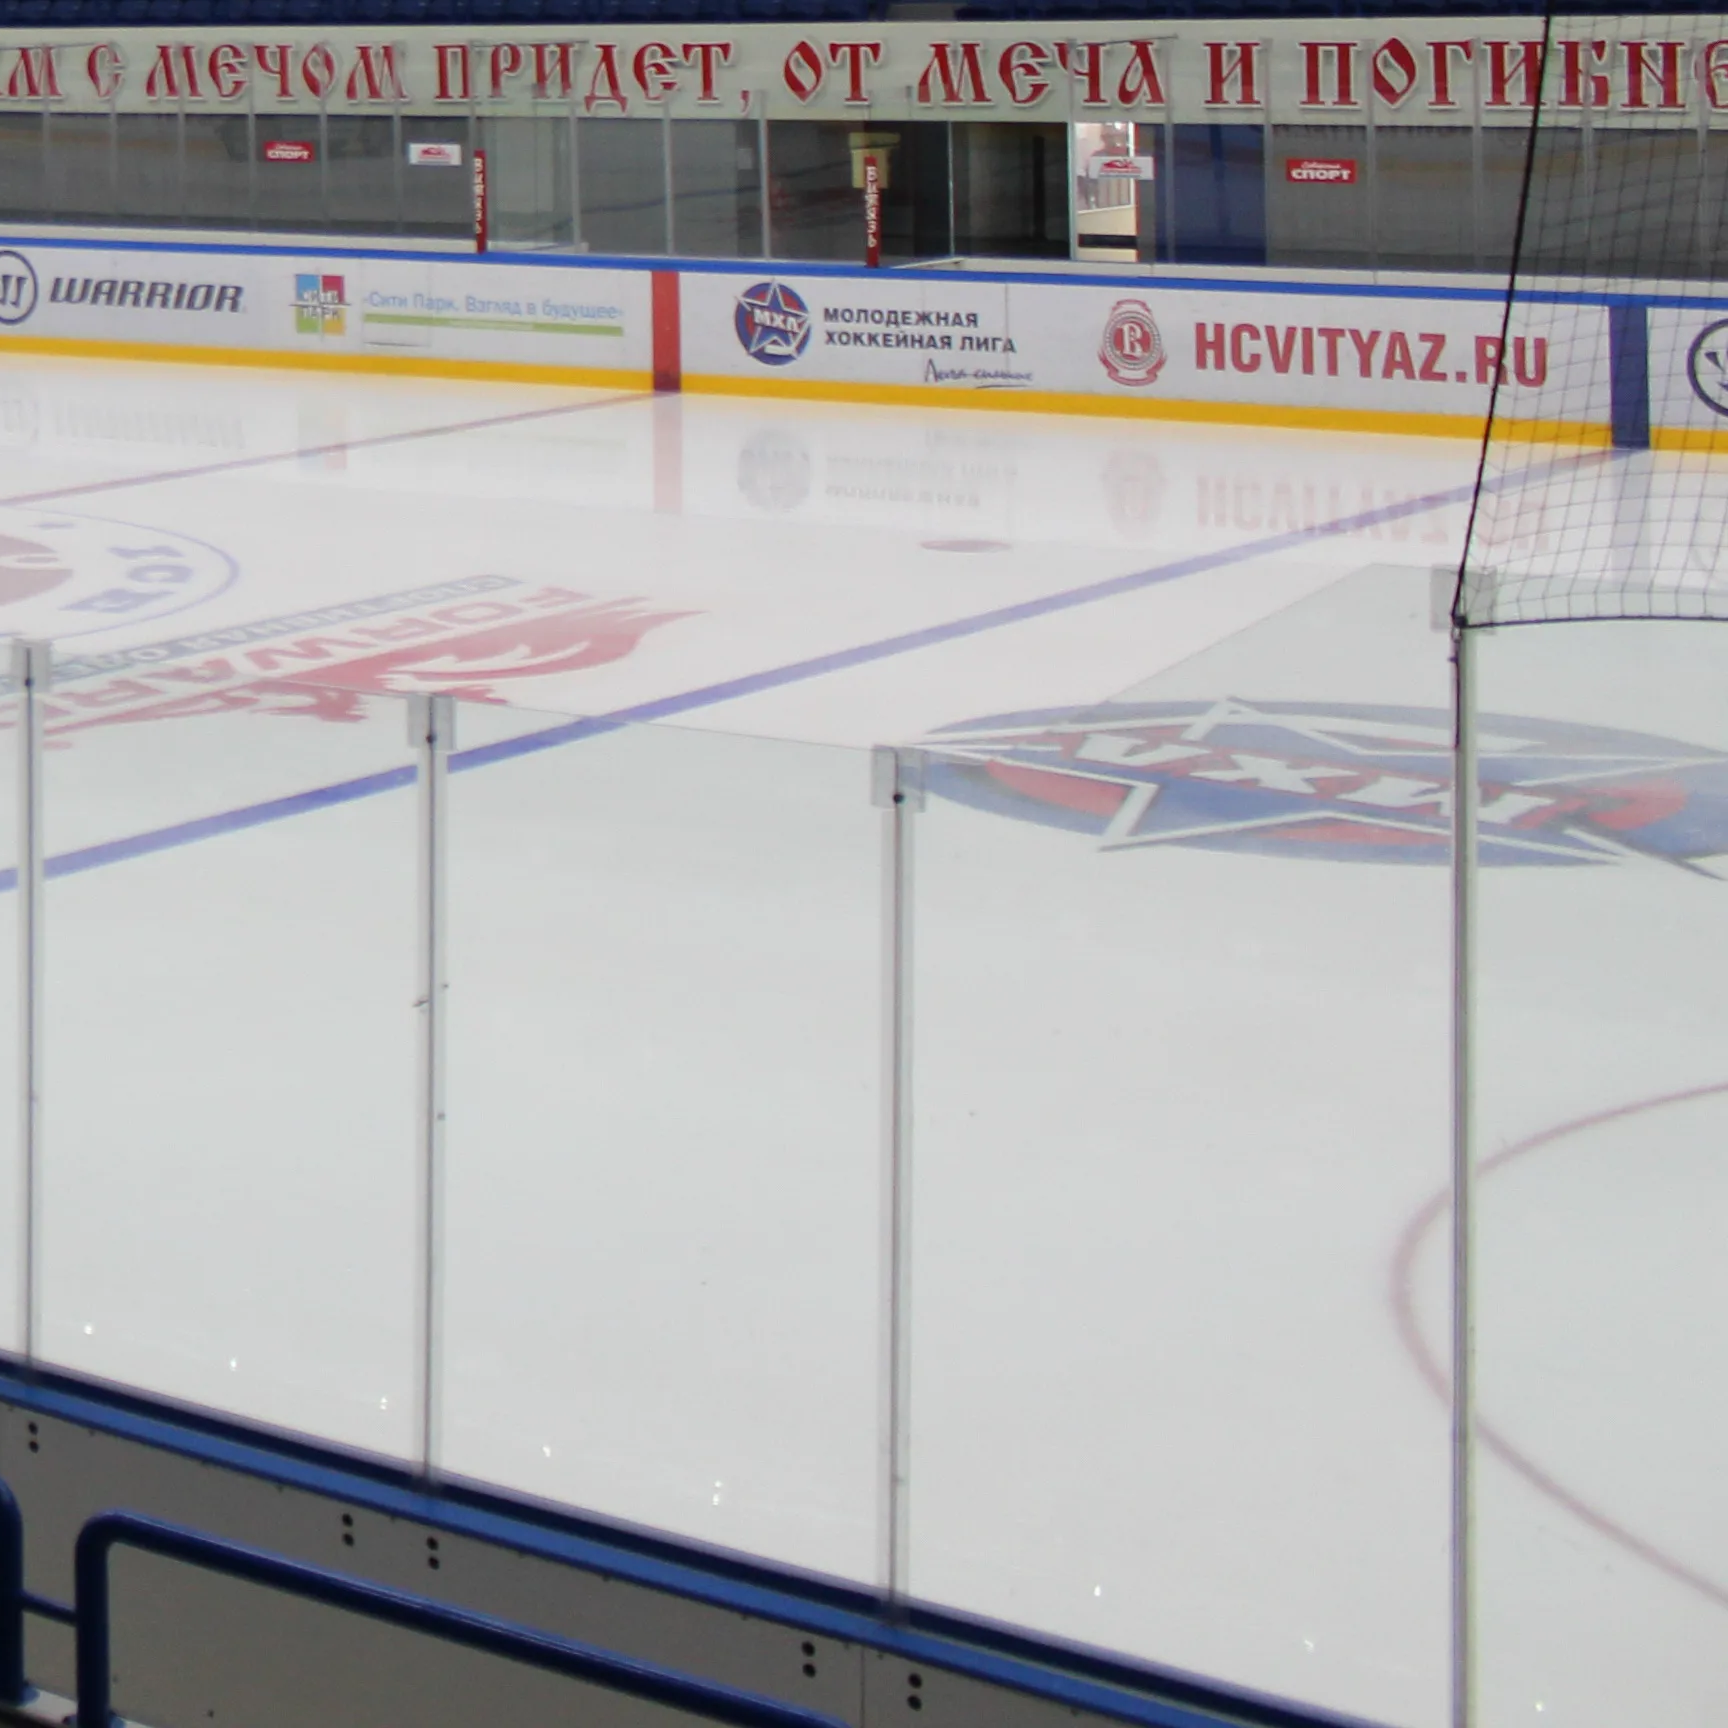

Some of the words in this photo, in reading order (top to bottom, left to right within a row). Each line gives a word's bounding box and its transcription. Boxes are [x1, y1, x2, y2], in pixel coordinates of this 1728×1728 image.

[86, 43, 124, 99] С
[145, 42, 410, 100] МЕЧОМ
[782, 40, 883, 103] ОТ
[916, 39, 1167, 105] МЕЧА
[1202, 41, 1262, 106] И
[48, 276, 245, 313] WARRIOR
[823, 307, 980, 329] МОЛОДЕЖНАЯ
[824, 329, 953, 351] ХОККЕЙНАЯ
[958, 336, 1018, 354] ЛИГА
[1193, 321, 1548, 389] HCVITYAZ.RU
